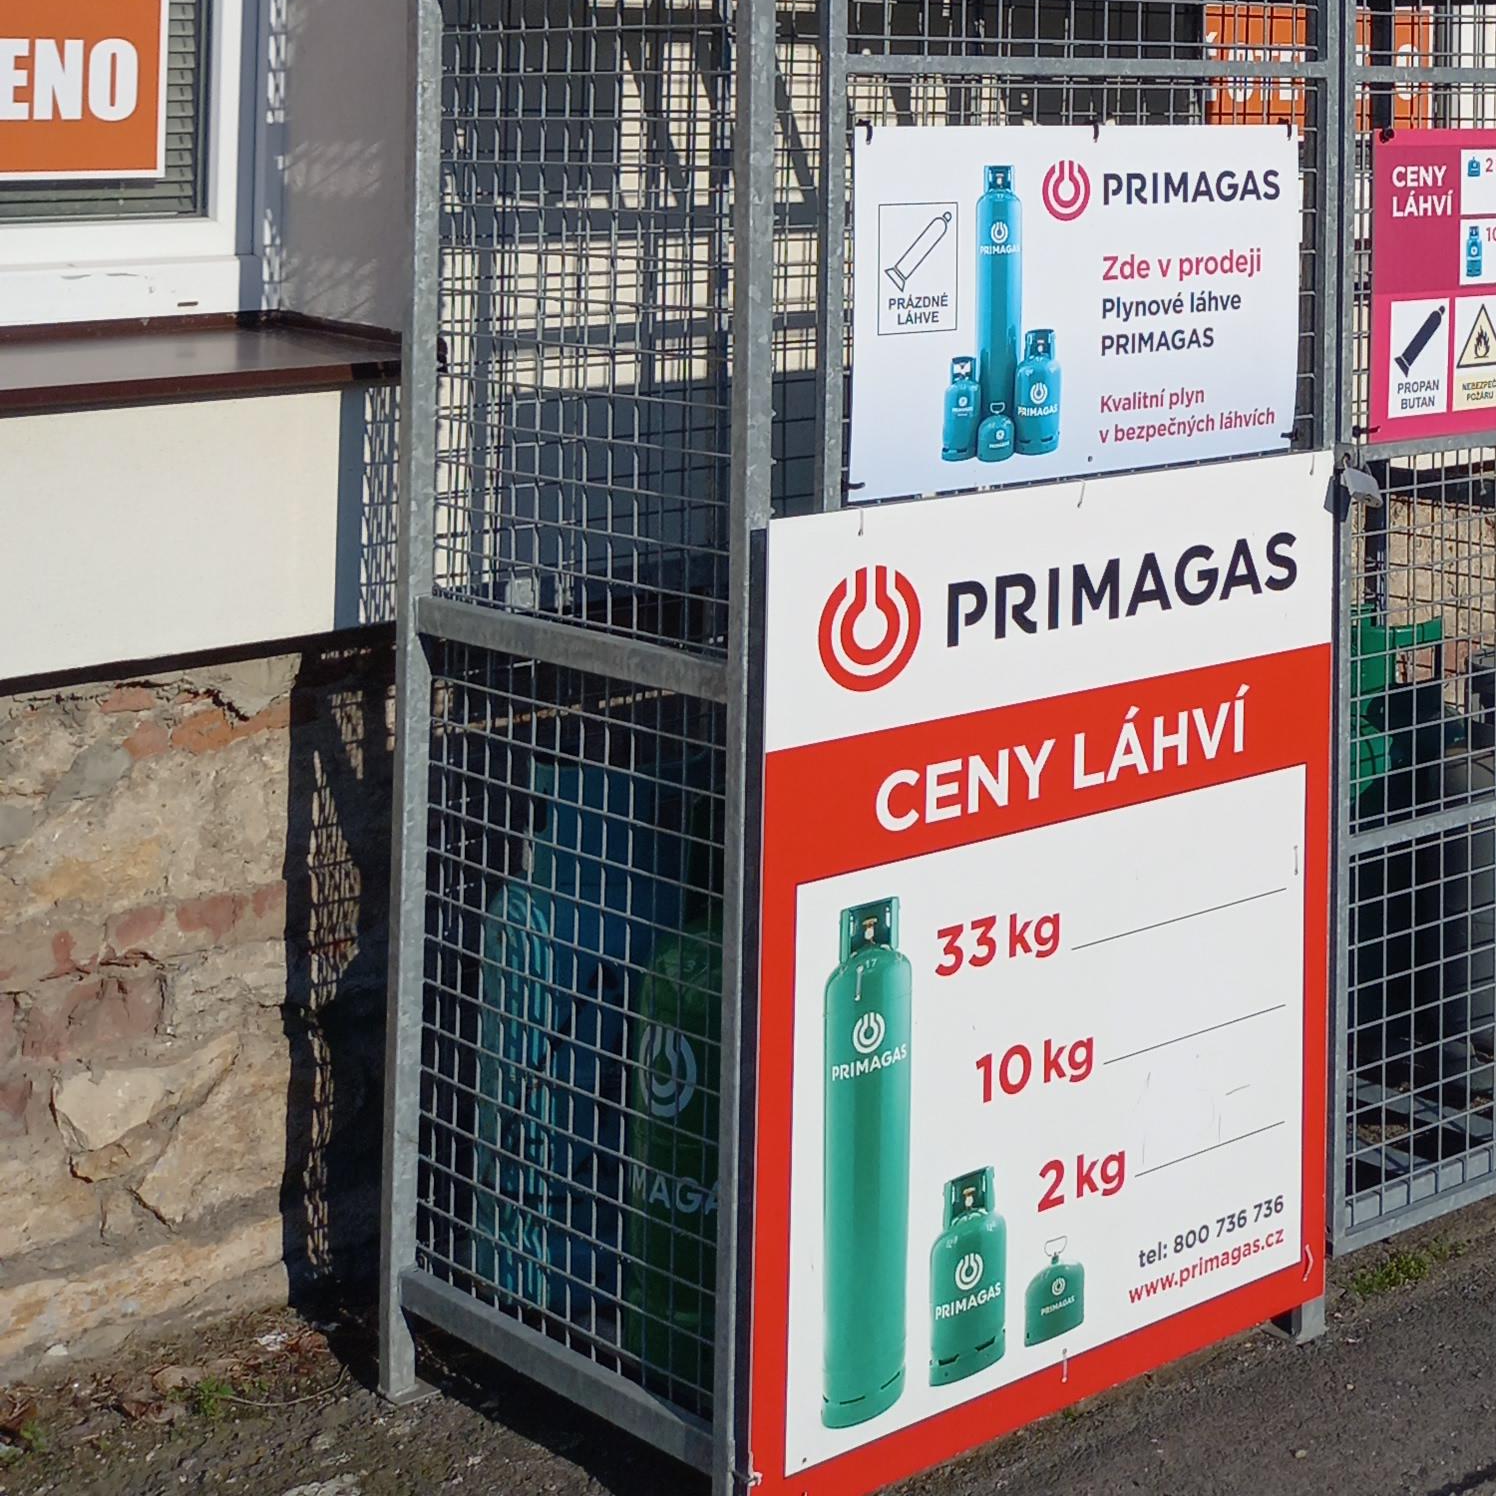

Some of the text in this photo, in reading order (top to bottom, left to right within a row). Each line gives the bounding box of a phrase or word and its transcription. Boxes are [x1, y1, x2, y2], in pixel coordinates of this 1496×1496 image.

[0, 38, 138, 121] ENO
[1392, 165, 1447, 187] CENY
[1486, 158, 1494, 172] 2
[1103, 169, 1281, 205] PRIMAGAS
[1392, 190, 1454, 217] LÁHVÍ
[1102, 248, 1262, 282] Zde v prodeji
[888, 293, 949, 310] PRÁZDNÉ
[897, 308, 940, 326] LÁHVE
[1101, 291, 1242, 322] Plynové láhve
[1101, 328, 1214, 356] PRIMAGAS
[1100, 389, 1205, 413] Kvalitní plyn
[1397, 379, 1440, 394] PROPAN
[1401, 396, 1436, 410] BUTAN
[1099, 407, 1276, 444] v bezpečných láhvích
[947, 531, 1298, 648] PRIMAGAS
[875, 684, 1250, 832] CENY LÁHVÍ
[935, 912, 1061, 977] 33 kg
[831, 1043, 907, 1082] PRIMAGAS
[976, 1036, 1094, 1104] 10 kg
[1037, 1150, 1126, 1213] 2 kg
[1138, 1195, 1284, 1268] tel: 800 736 736
[1128, 1228, 1285, 1304] www.primagas.cz
[935, 1282, 1002, 1321] PRIMAGAS
